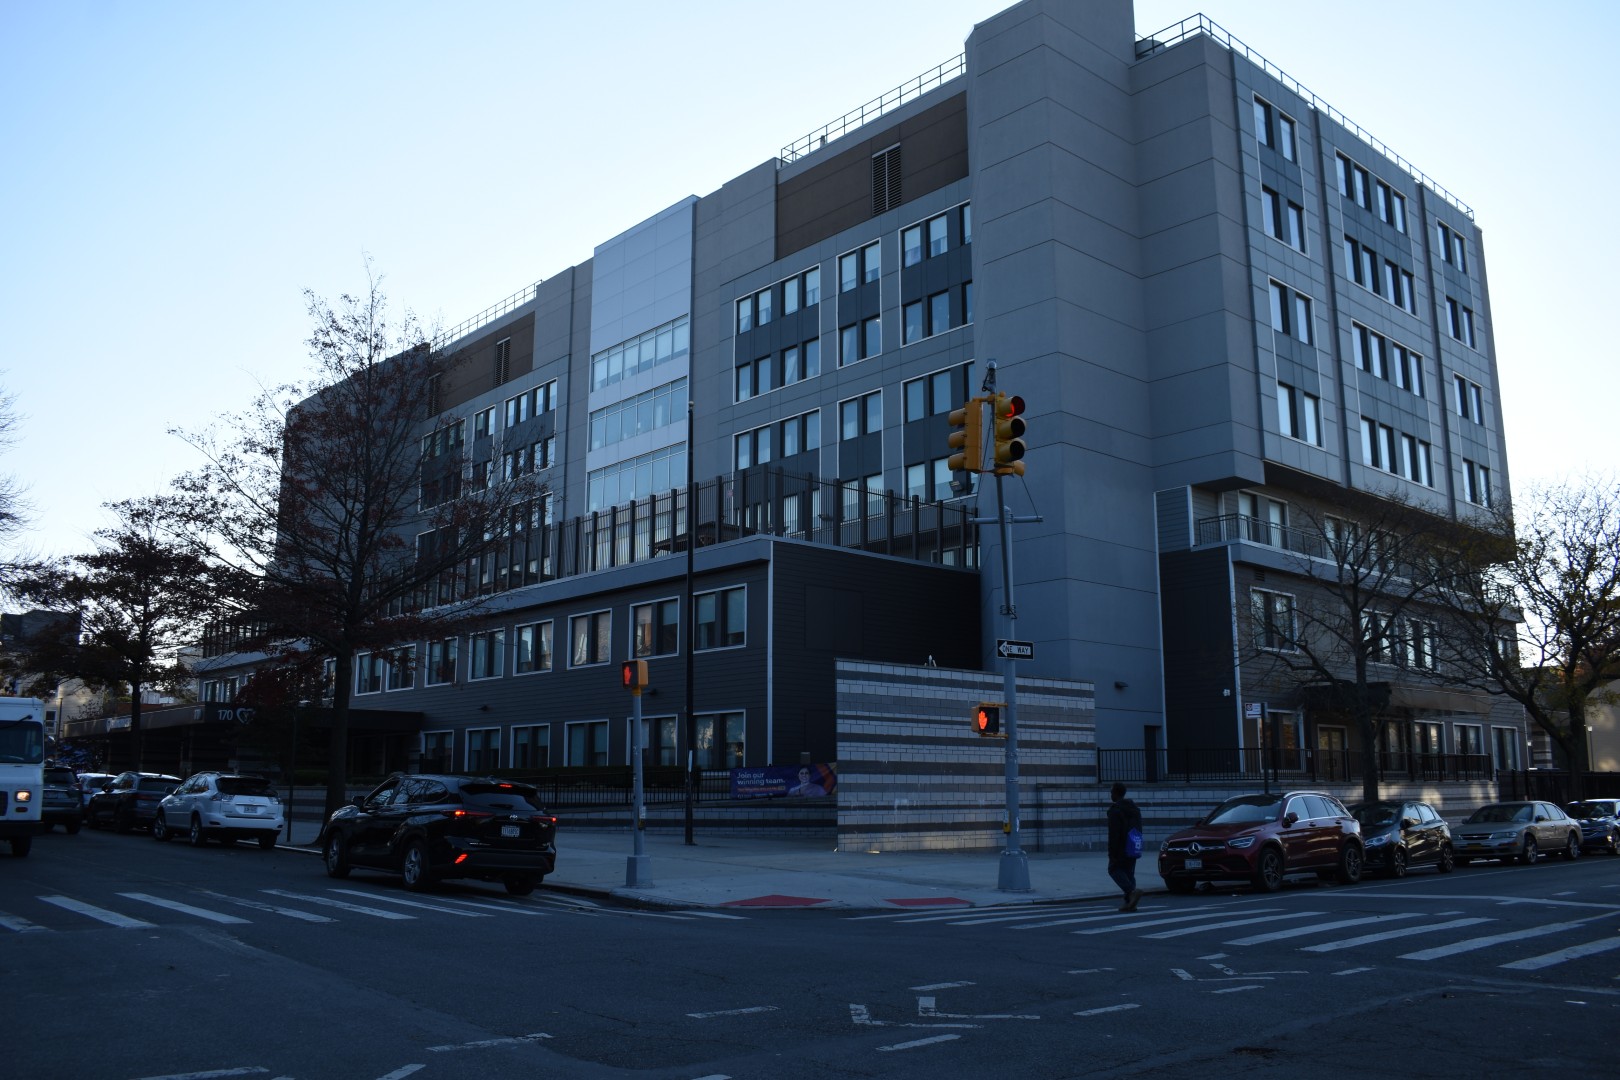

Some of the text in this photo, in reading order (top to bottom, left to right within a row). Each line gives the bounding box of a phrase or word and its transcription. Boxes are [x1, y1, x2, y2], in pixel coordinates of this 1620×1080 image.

[1002, 645, 1029, 654] ONE WAY
[218, 709, 234, 721] 170
[737, 778, 765, 786] winning
